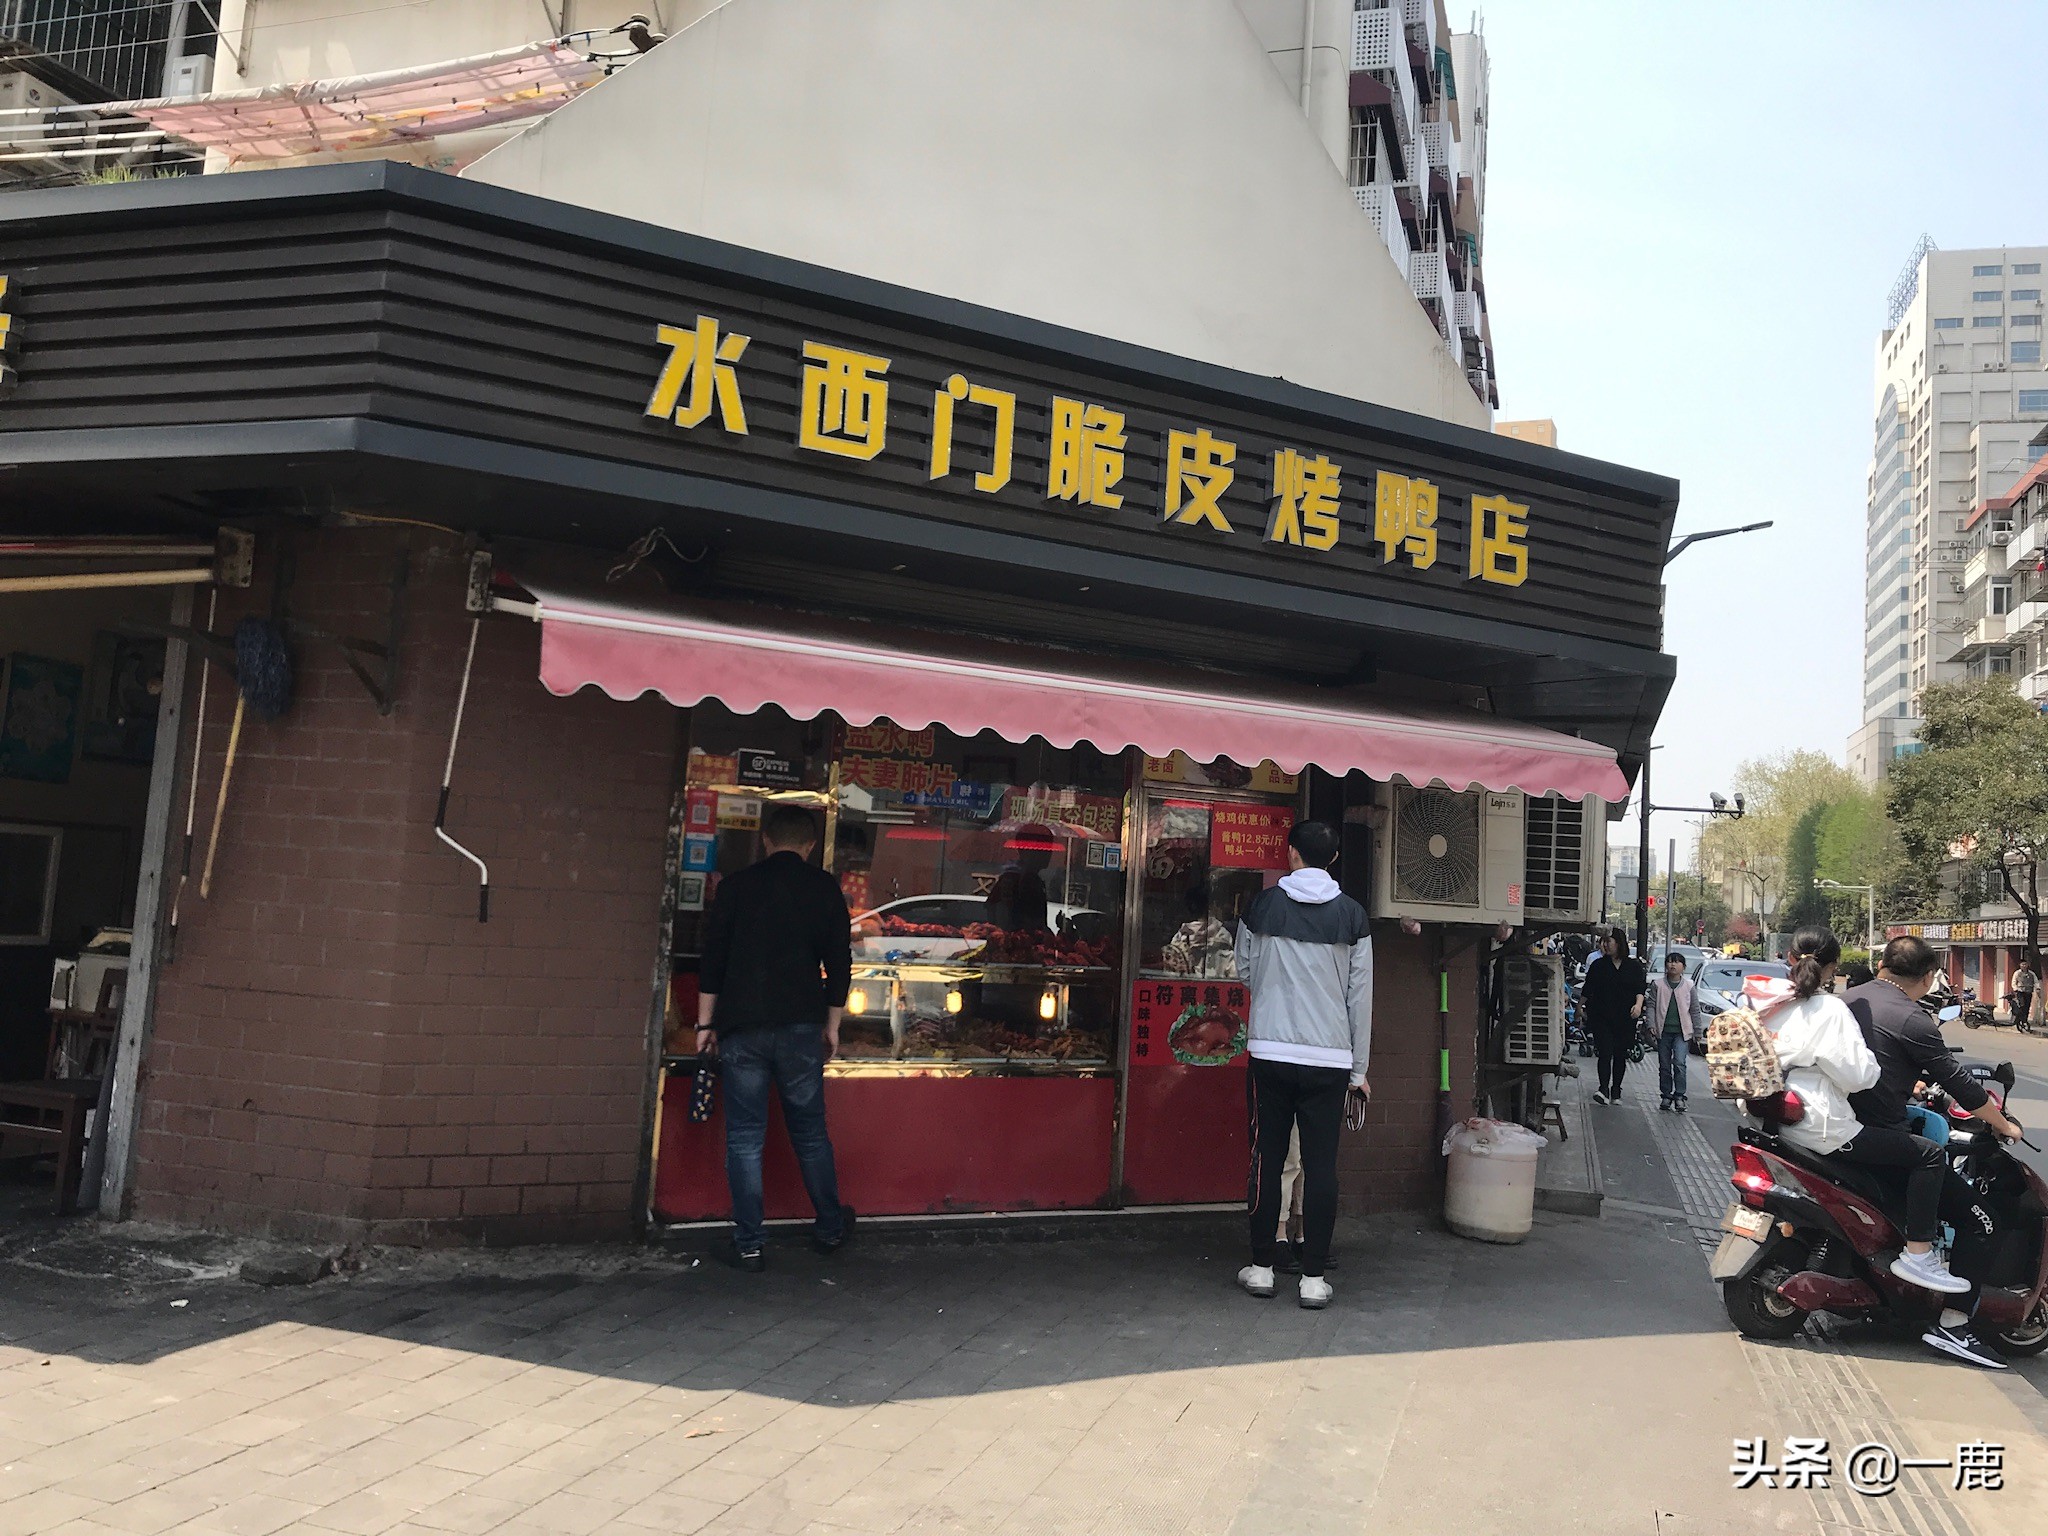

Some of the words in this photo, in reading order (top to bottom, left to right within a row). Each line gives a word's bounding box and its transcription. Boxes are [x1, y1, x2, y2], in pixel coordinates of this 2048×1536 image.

[644, 314, 1531, 587] 水西门脆皮烤鸭店
[844, 720, 935, 758] 盐水鸭
[839, 754, 958, 797] 夫妻肺片
[1009, 796, 1117, 832] 现场真空包装
[1215, 811, 1271, 827] 烧鸡优惠价
[1282, 816, 1292, 828] 元
[1221, 831, 1284, 846] 酱鸭12.8元/斤
[1225, 844, 1265, 858] 鸭头一个
[1136, 990, 1151, 1057] 口味独特
